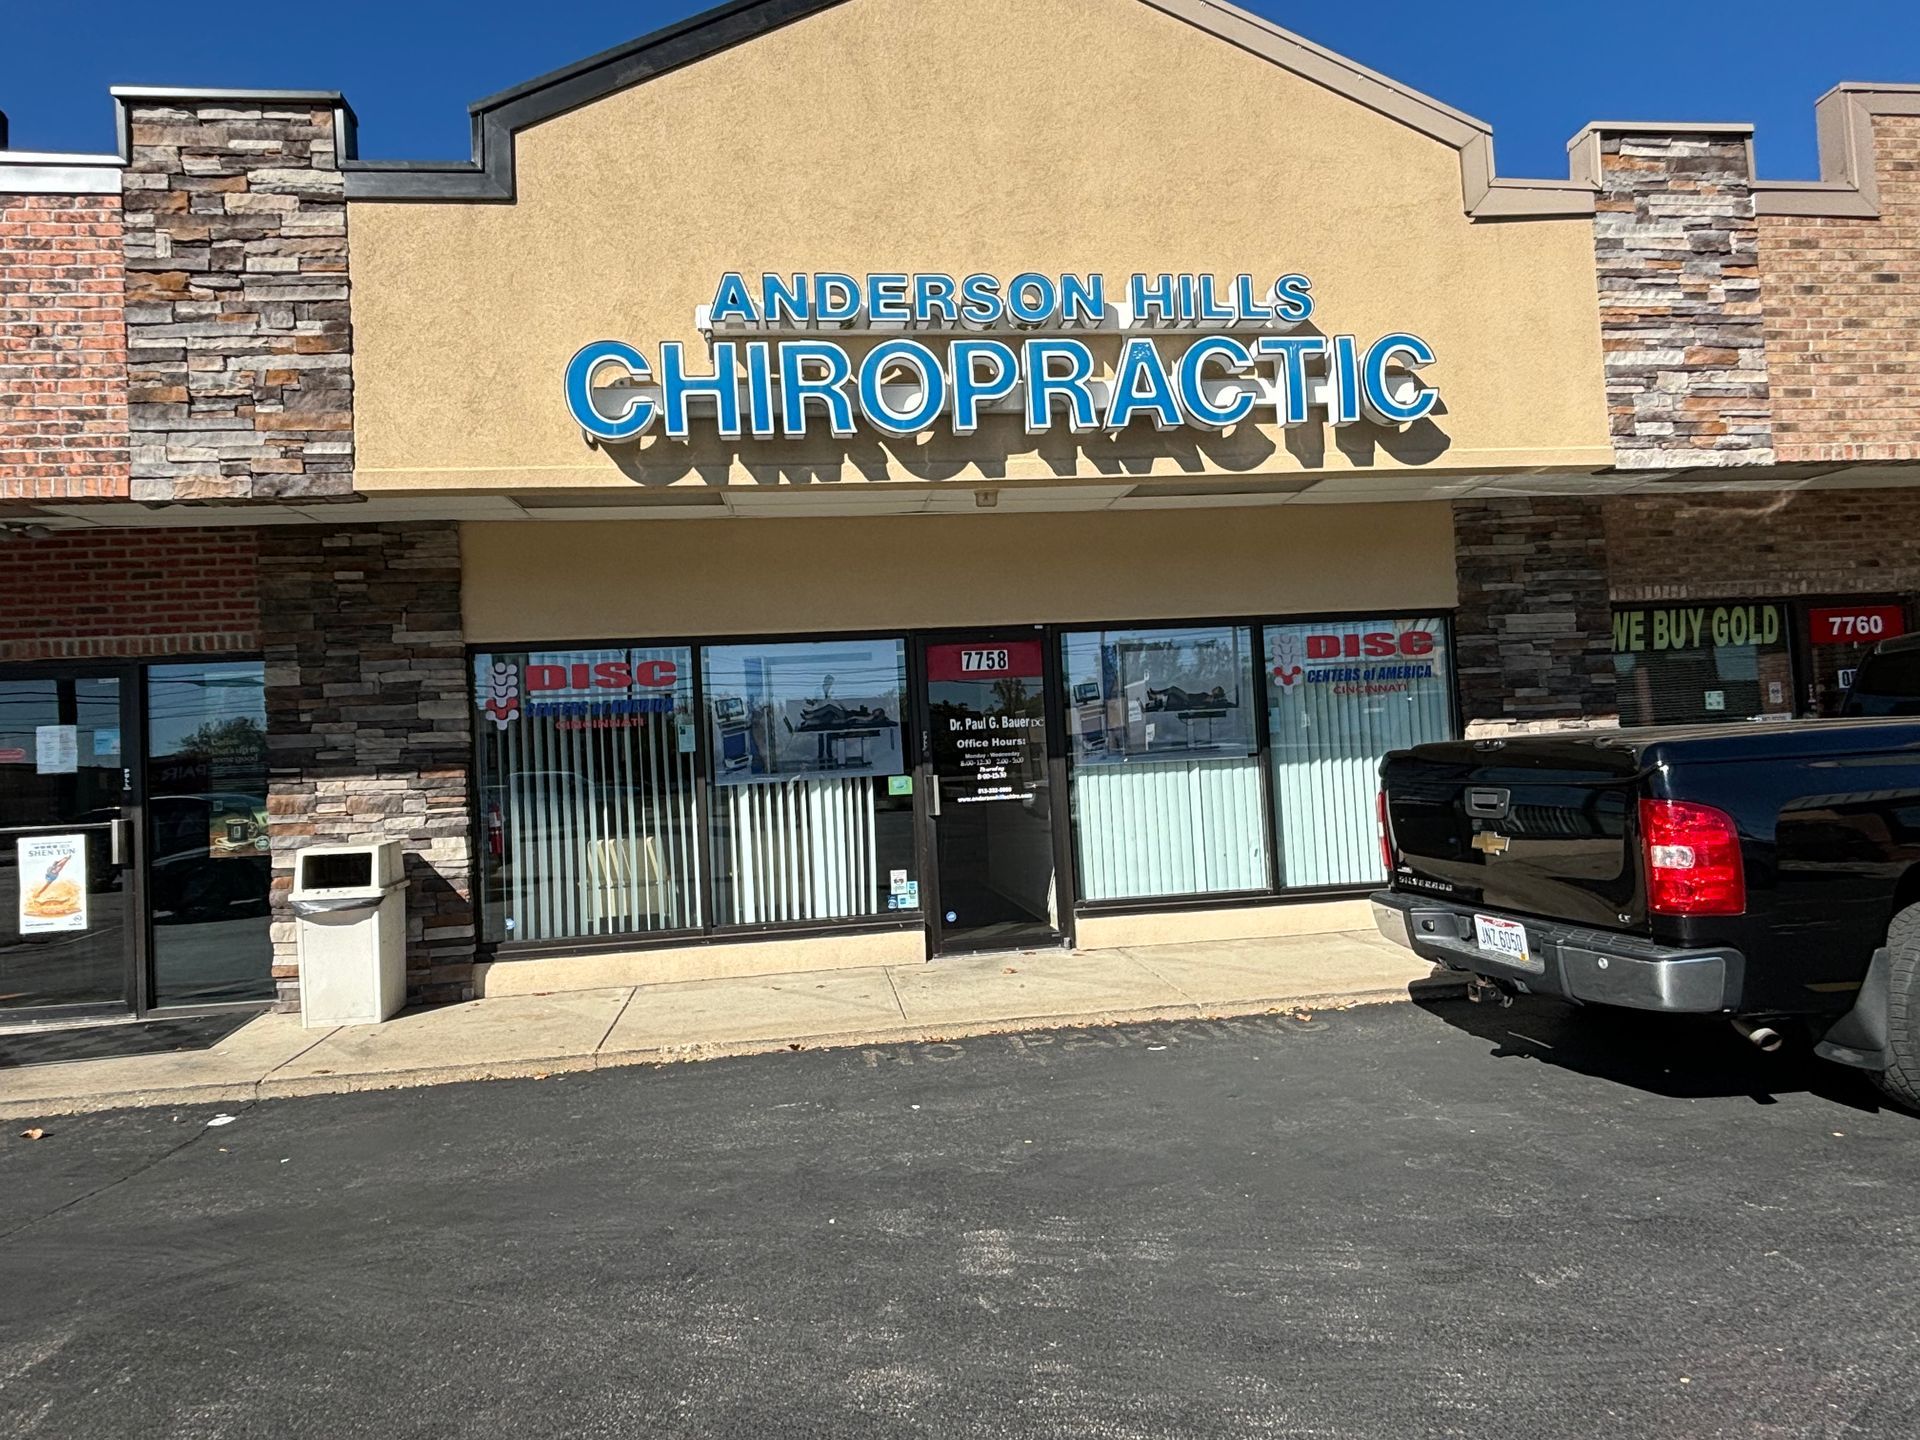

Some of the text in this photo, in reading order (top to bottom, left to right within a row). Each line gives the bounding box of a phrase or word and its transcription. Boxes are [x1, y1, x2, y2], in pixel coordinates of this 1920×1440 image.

[709, 271, 1315, 324] ANDERSON HILLS
[564, 332, 1439, 442] CHIROPRACTIC
[1652, 608, 1705, 650] BUY
[1712, 604, 1780, 648] GOLD
[1828, 615, 1883, 636] 7760
[1306, 630, 1434, 659] DISC
[963, 651, 1007, 670] 7758
[525, 660, 677, 691] DISC
[1307, 665, 1432, 684] CENTERS of AMERICA
[1333, 683, 1408, 695] CINCINNATI
[949, 718, 963, 731] Dr.
[965, 717, 987, 730] Paul
[988, 716, 999, 729] G.
[1001, 715, 1030, 728] Bauer
[956, 738, 1026, 748] Office Hours:
[28, 848, 76, 858] SHEN YUN
[1499, 930, 1523, 952] 6050
